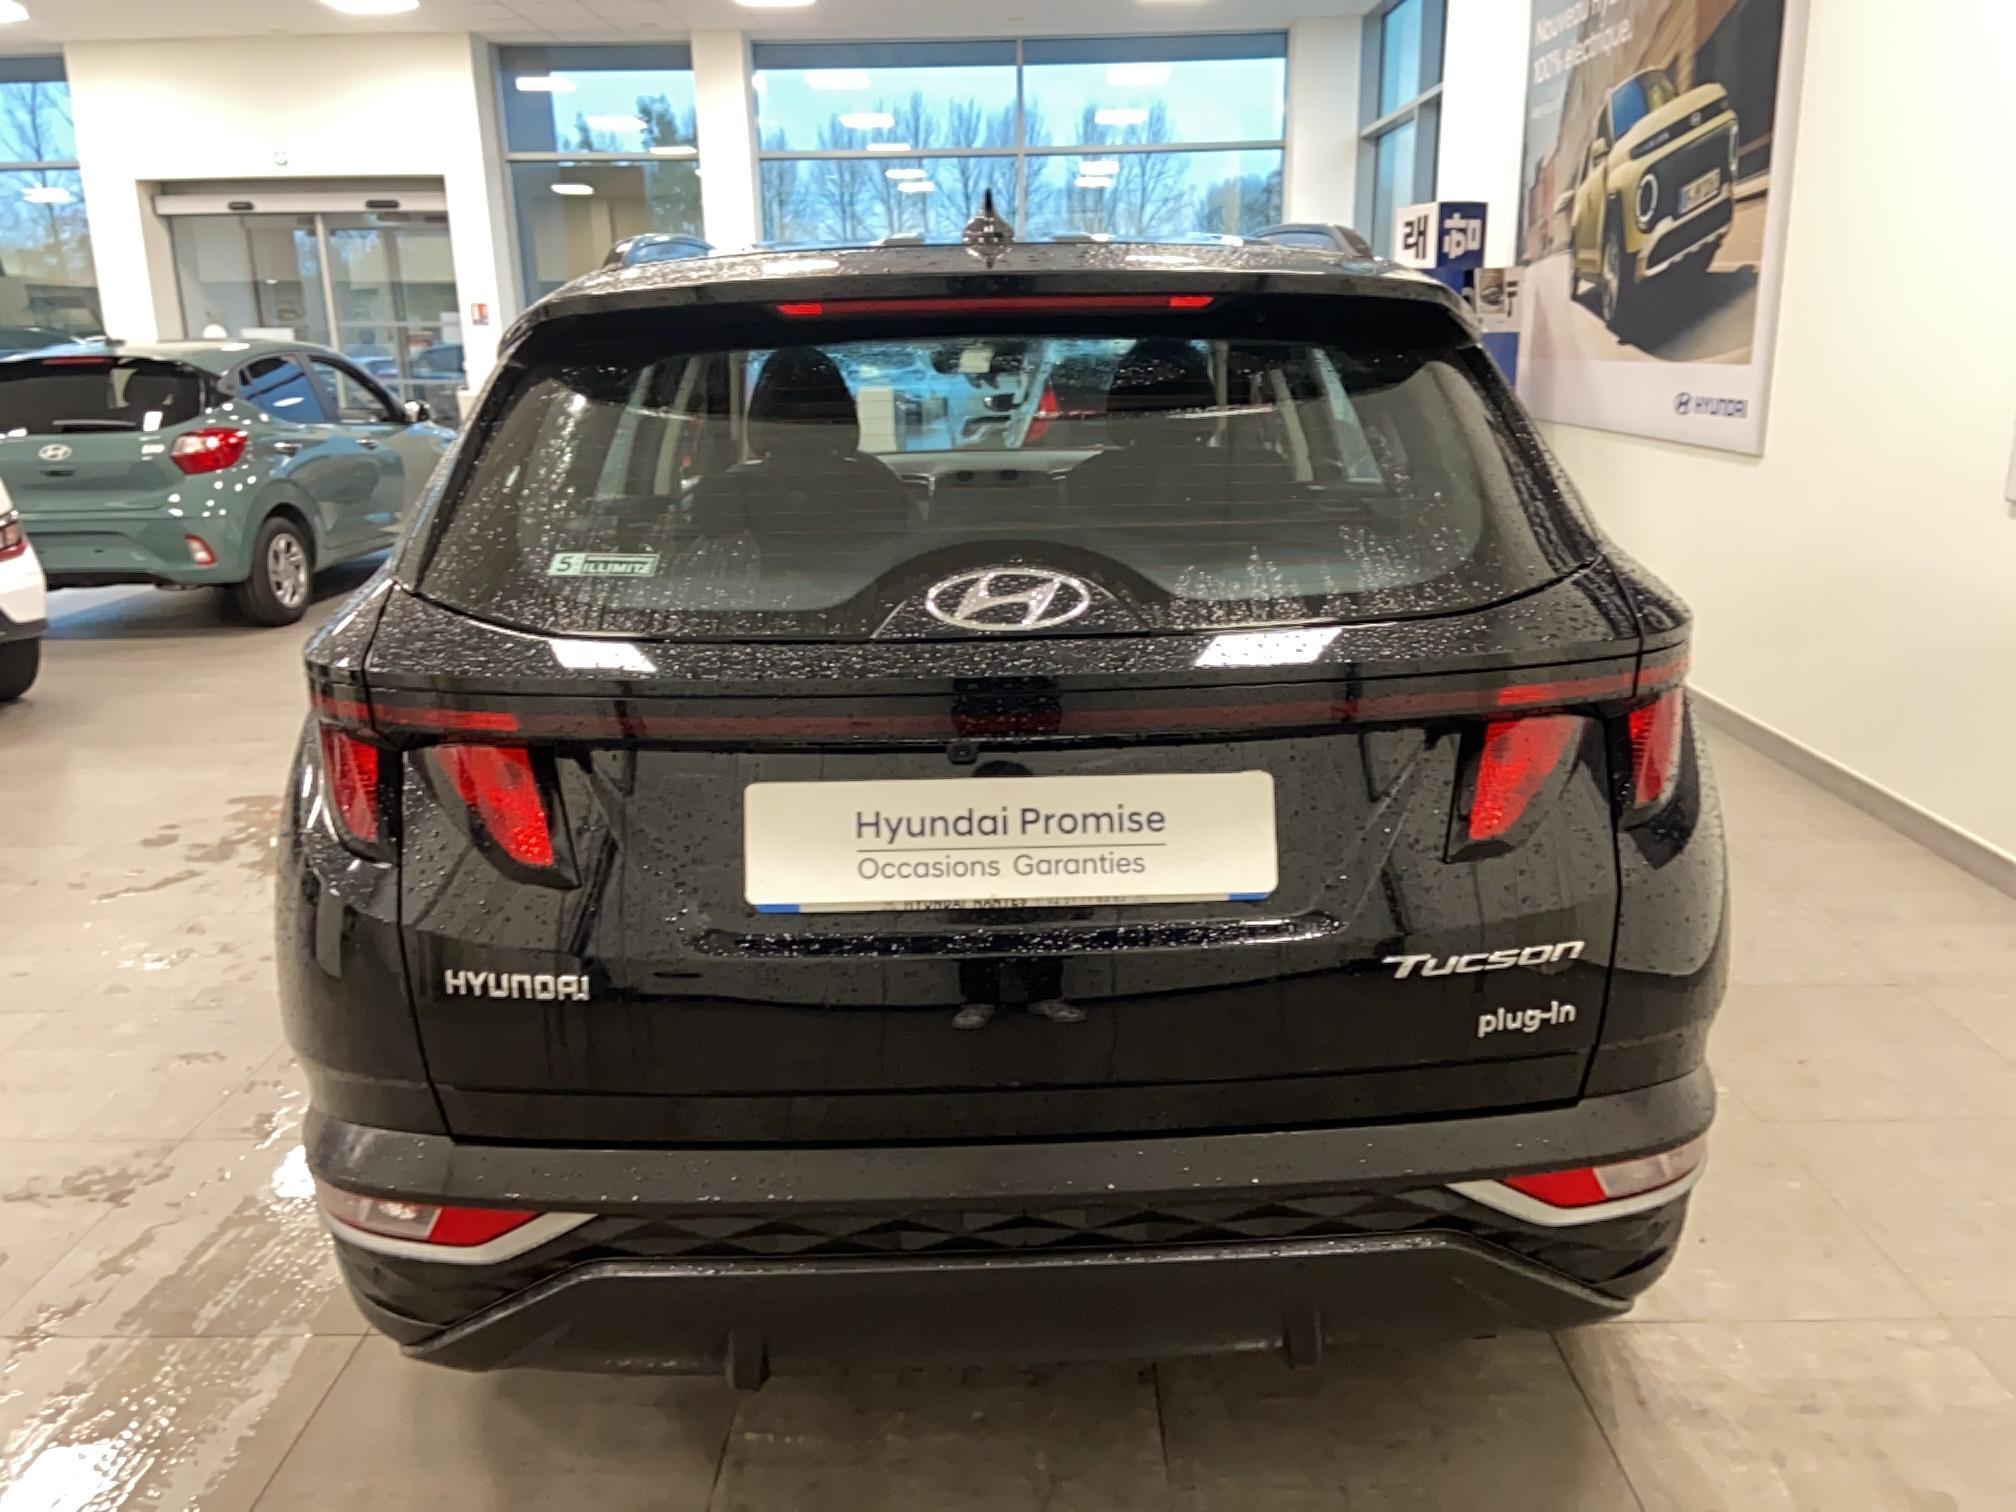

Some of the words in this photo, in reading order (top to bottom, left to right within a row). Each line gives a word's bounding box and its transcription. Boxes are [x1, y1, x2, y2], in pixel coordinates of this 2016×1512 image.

[1695, 397, 1748, 418] HYUNDAI
[856, 806, 1008, 845] Hyundai
[1020, 803, 1167, 835] Promise
[857, 855, 1001, 880] Occasions
[1012, 851, 1146, 876] Garanties
[444, 969, 590, 1001] HYUNDAI
